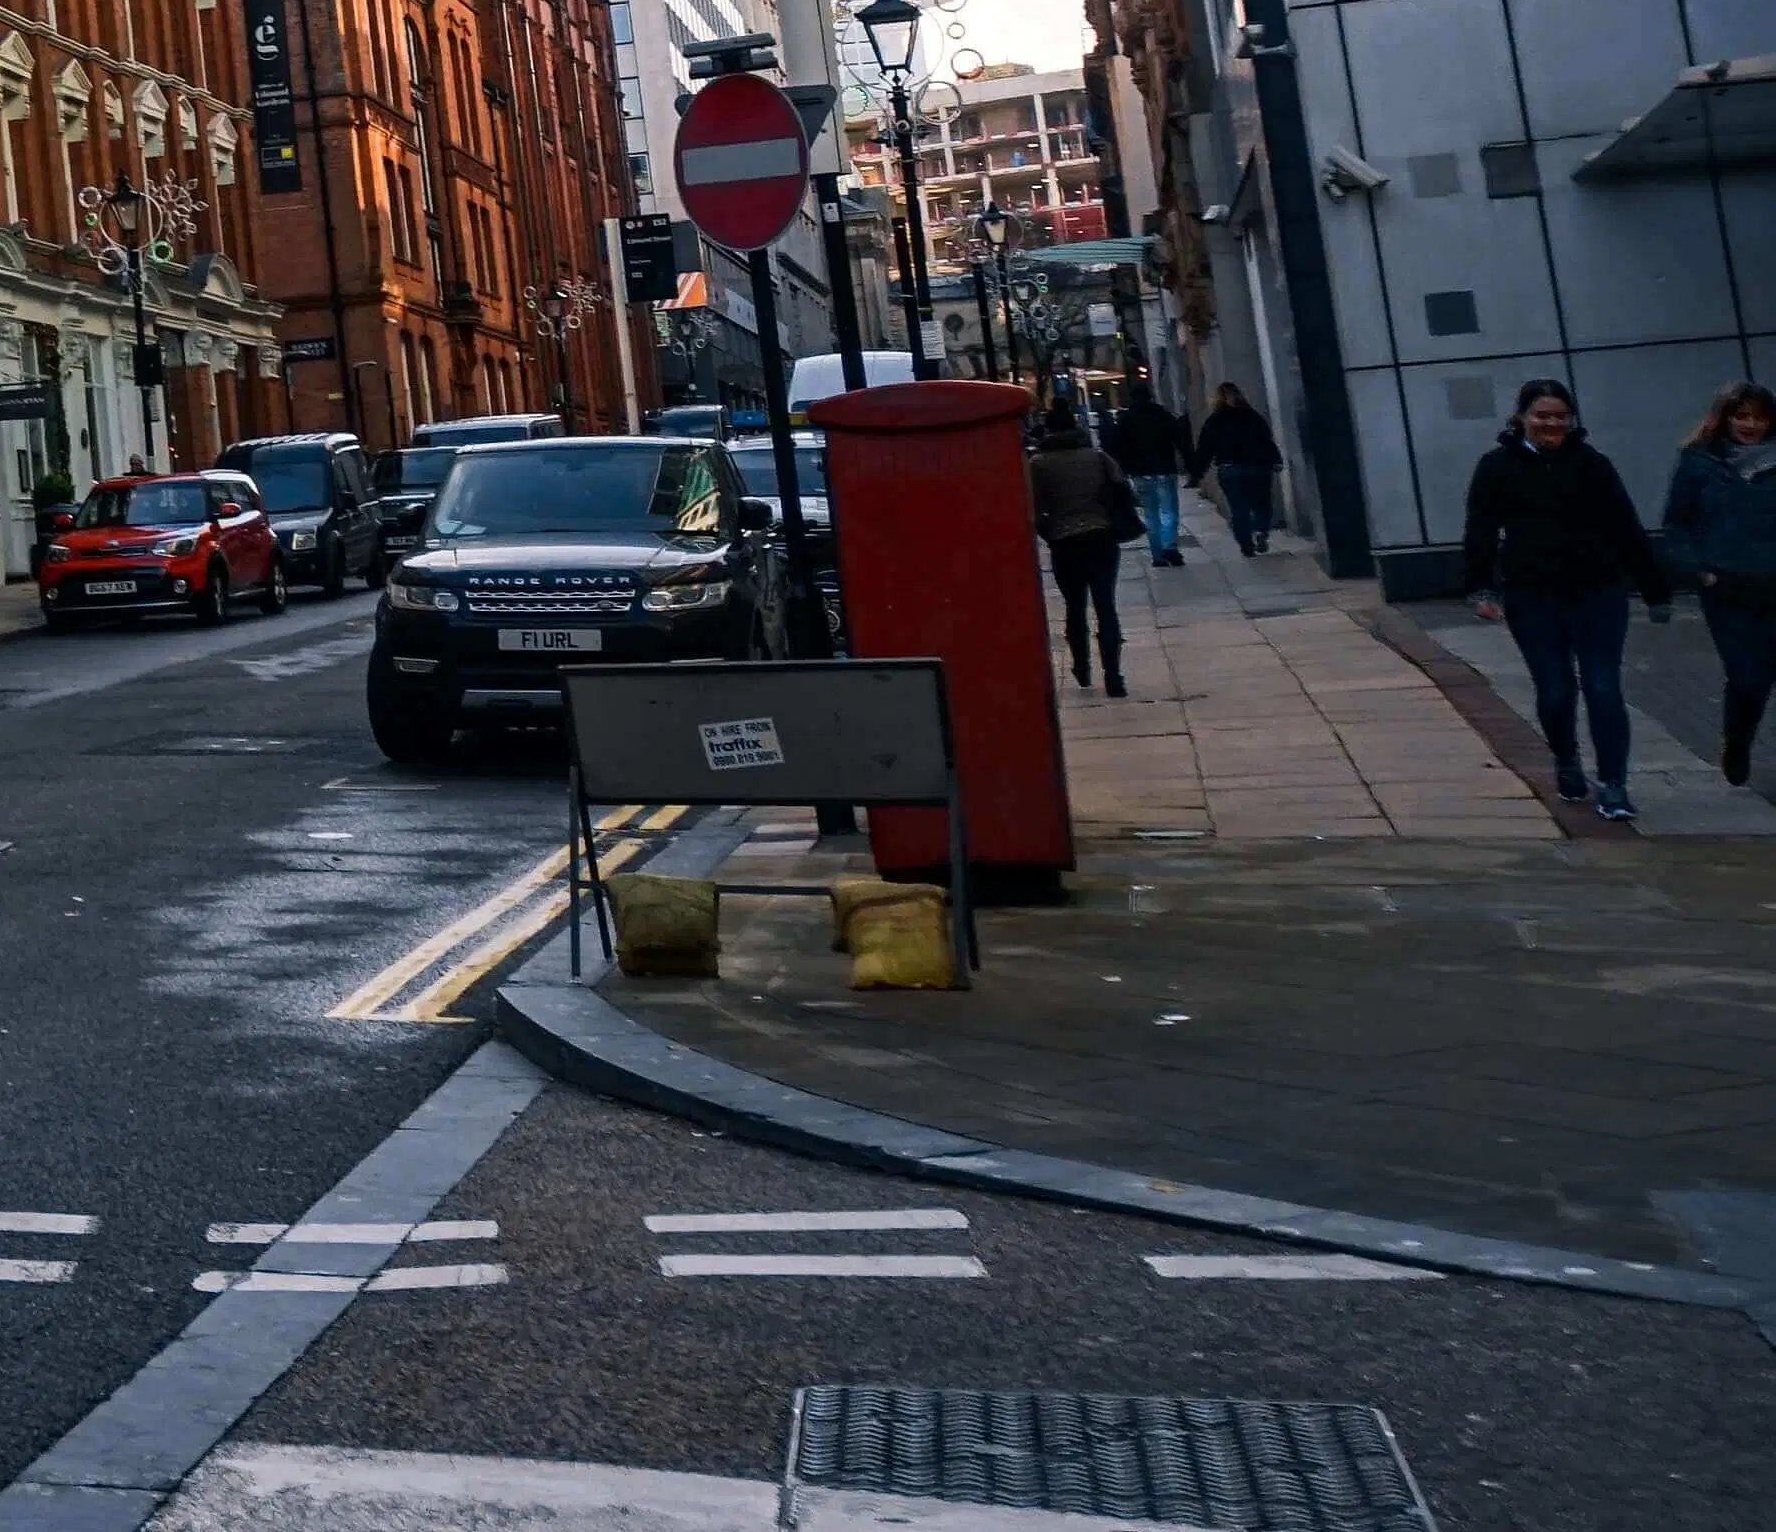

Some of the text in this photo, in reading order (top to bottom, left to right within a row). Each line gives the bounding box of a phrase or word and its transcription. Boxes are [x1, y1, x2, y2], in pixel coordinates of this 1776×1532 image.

[468, 576, 631, 585] RANGE ROVER
[521, 631, 578, 648] F1 URL
[721, 724, 742, 735] HIRE
[708, 737, 763, 753] traffix
